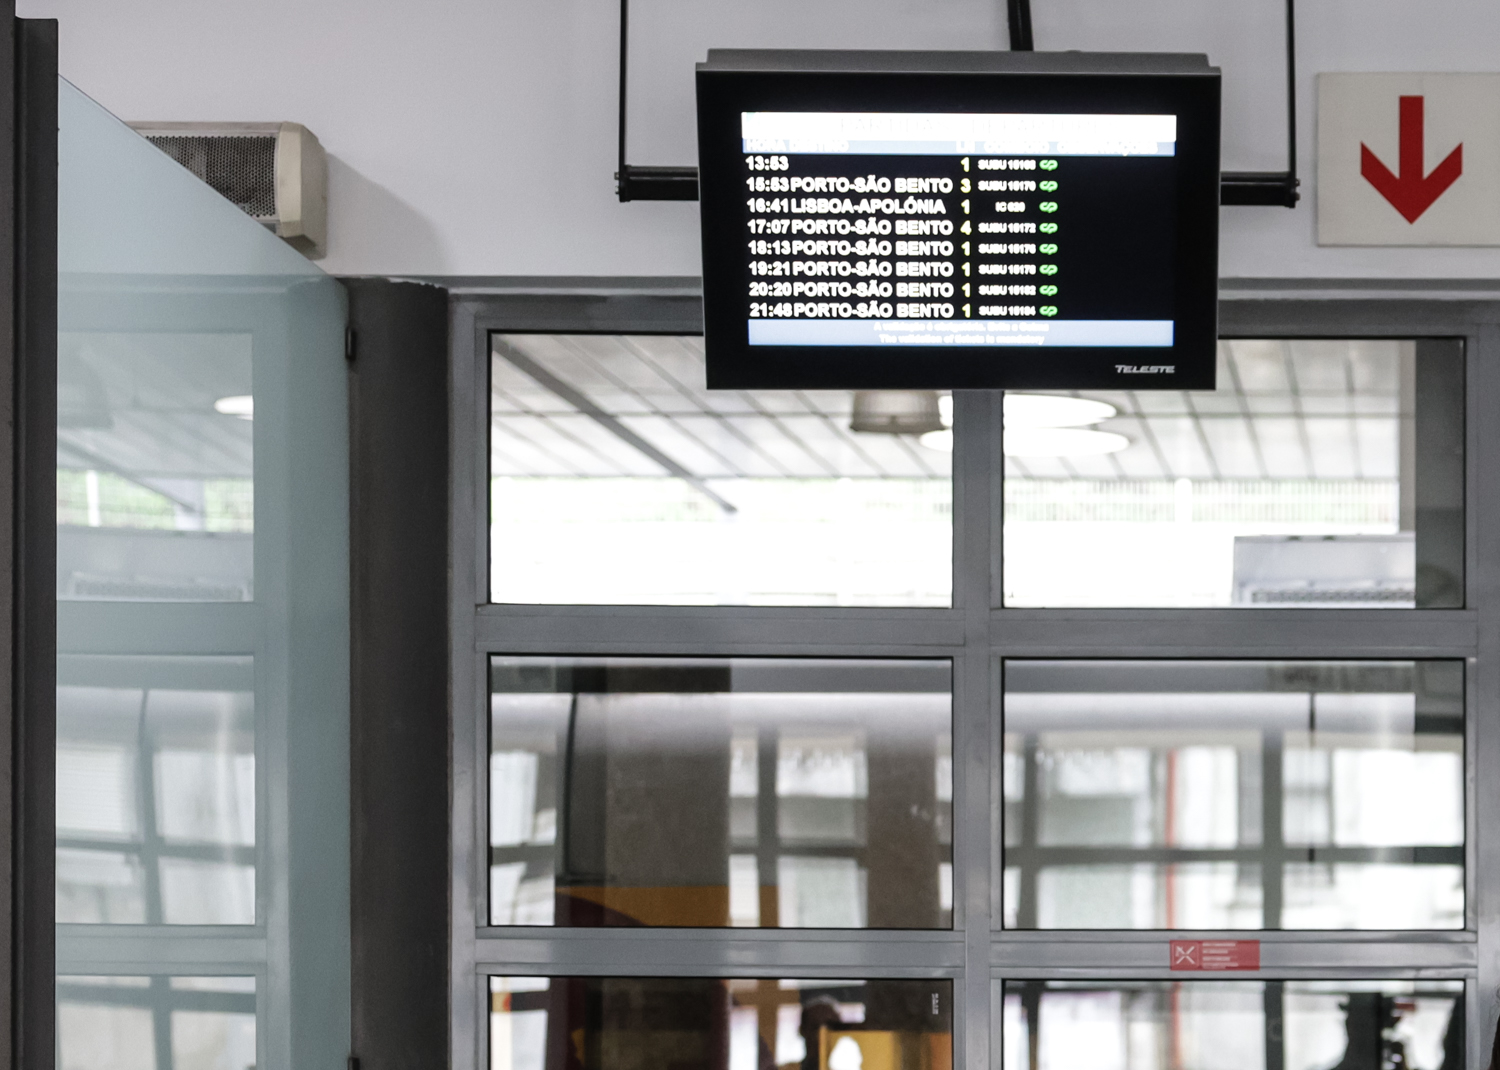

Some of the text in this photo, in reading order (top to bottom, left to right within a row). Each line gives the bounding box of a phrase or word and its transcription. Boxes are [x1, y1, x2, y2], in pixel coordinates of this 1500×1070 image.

[746, 156, 789, 170] 13:53
[961, 157, 969, 172] 1
[746, 177, 789, 192] 15:53
[791, 175, 891, 193] PORTO-SÃO
[895, 178, 953, 193] BENTO
[961, 179, 971, 193] 3
[747, 198, 788, 213] 16:41
[791, 196, 946, 214] LISBOA-APOLÓNIA
[961, 200, 969, 214] 1
[747, 219, 790, 234] 17:07
[792, 217, 892, 235] PORTO-SÃO
[895, 220, 953, 235] BENTO
[960, 221, 972, 235] 4
[748, 240, 791, 255] 18:13
[792, 238, 892, 256] PORTO-SÃO
[896, 241, 953, 256] BENTO
[961, 242, 970, 256] 1
[749, 261, 790, 276] 19:21
[793, 259, 892, 277] PORTO-SÃO
[896, 262, 954, 277] BENTO
[962, 263, 970, 276] 1
[749, 282, 792, 296] 20:20
[794, 279, 893, 297] PORTO-SÃO
[896, 282, 954, 297] BENTO
[962, 284, 970, 297] 1
[750, 303, 792, 317] 21:48
[794, 300, 893, 318] PORTO-SÃO
[897, 303, 954, 318] BENTO
[962, 305, 970, 318] 1
[1115, 365, 1175, 373] TELESTE
